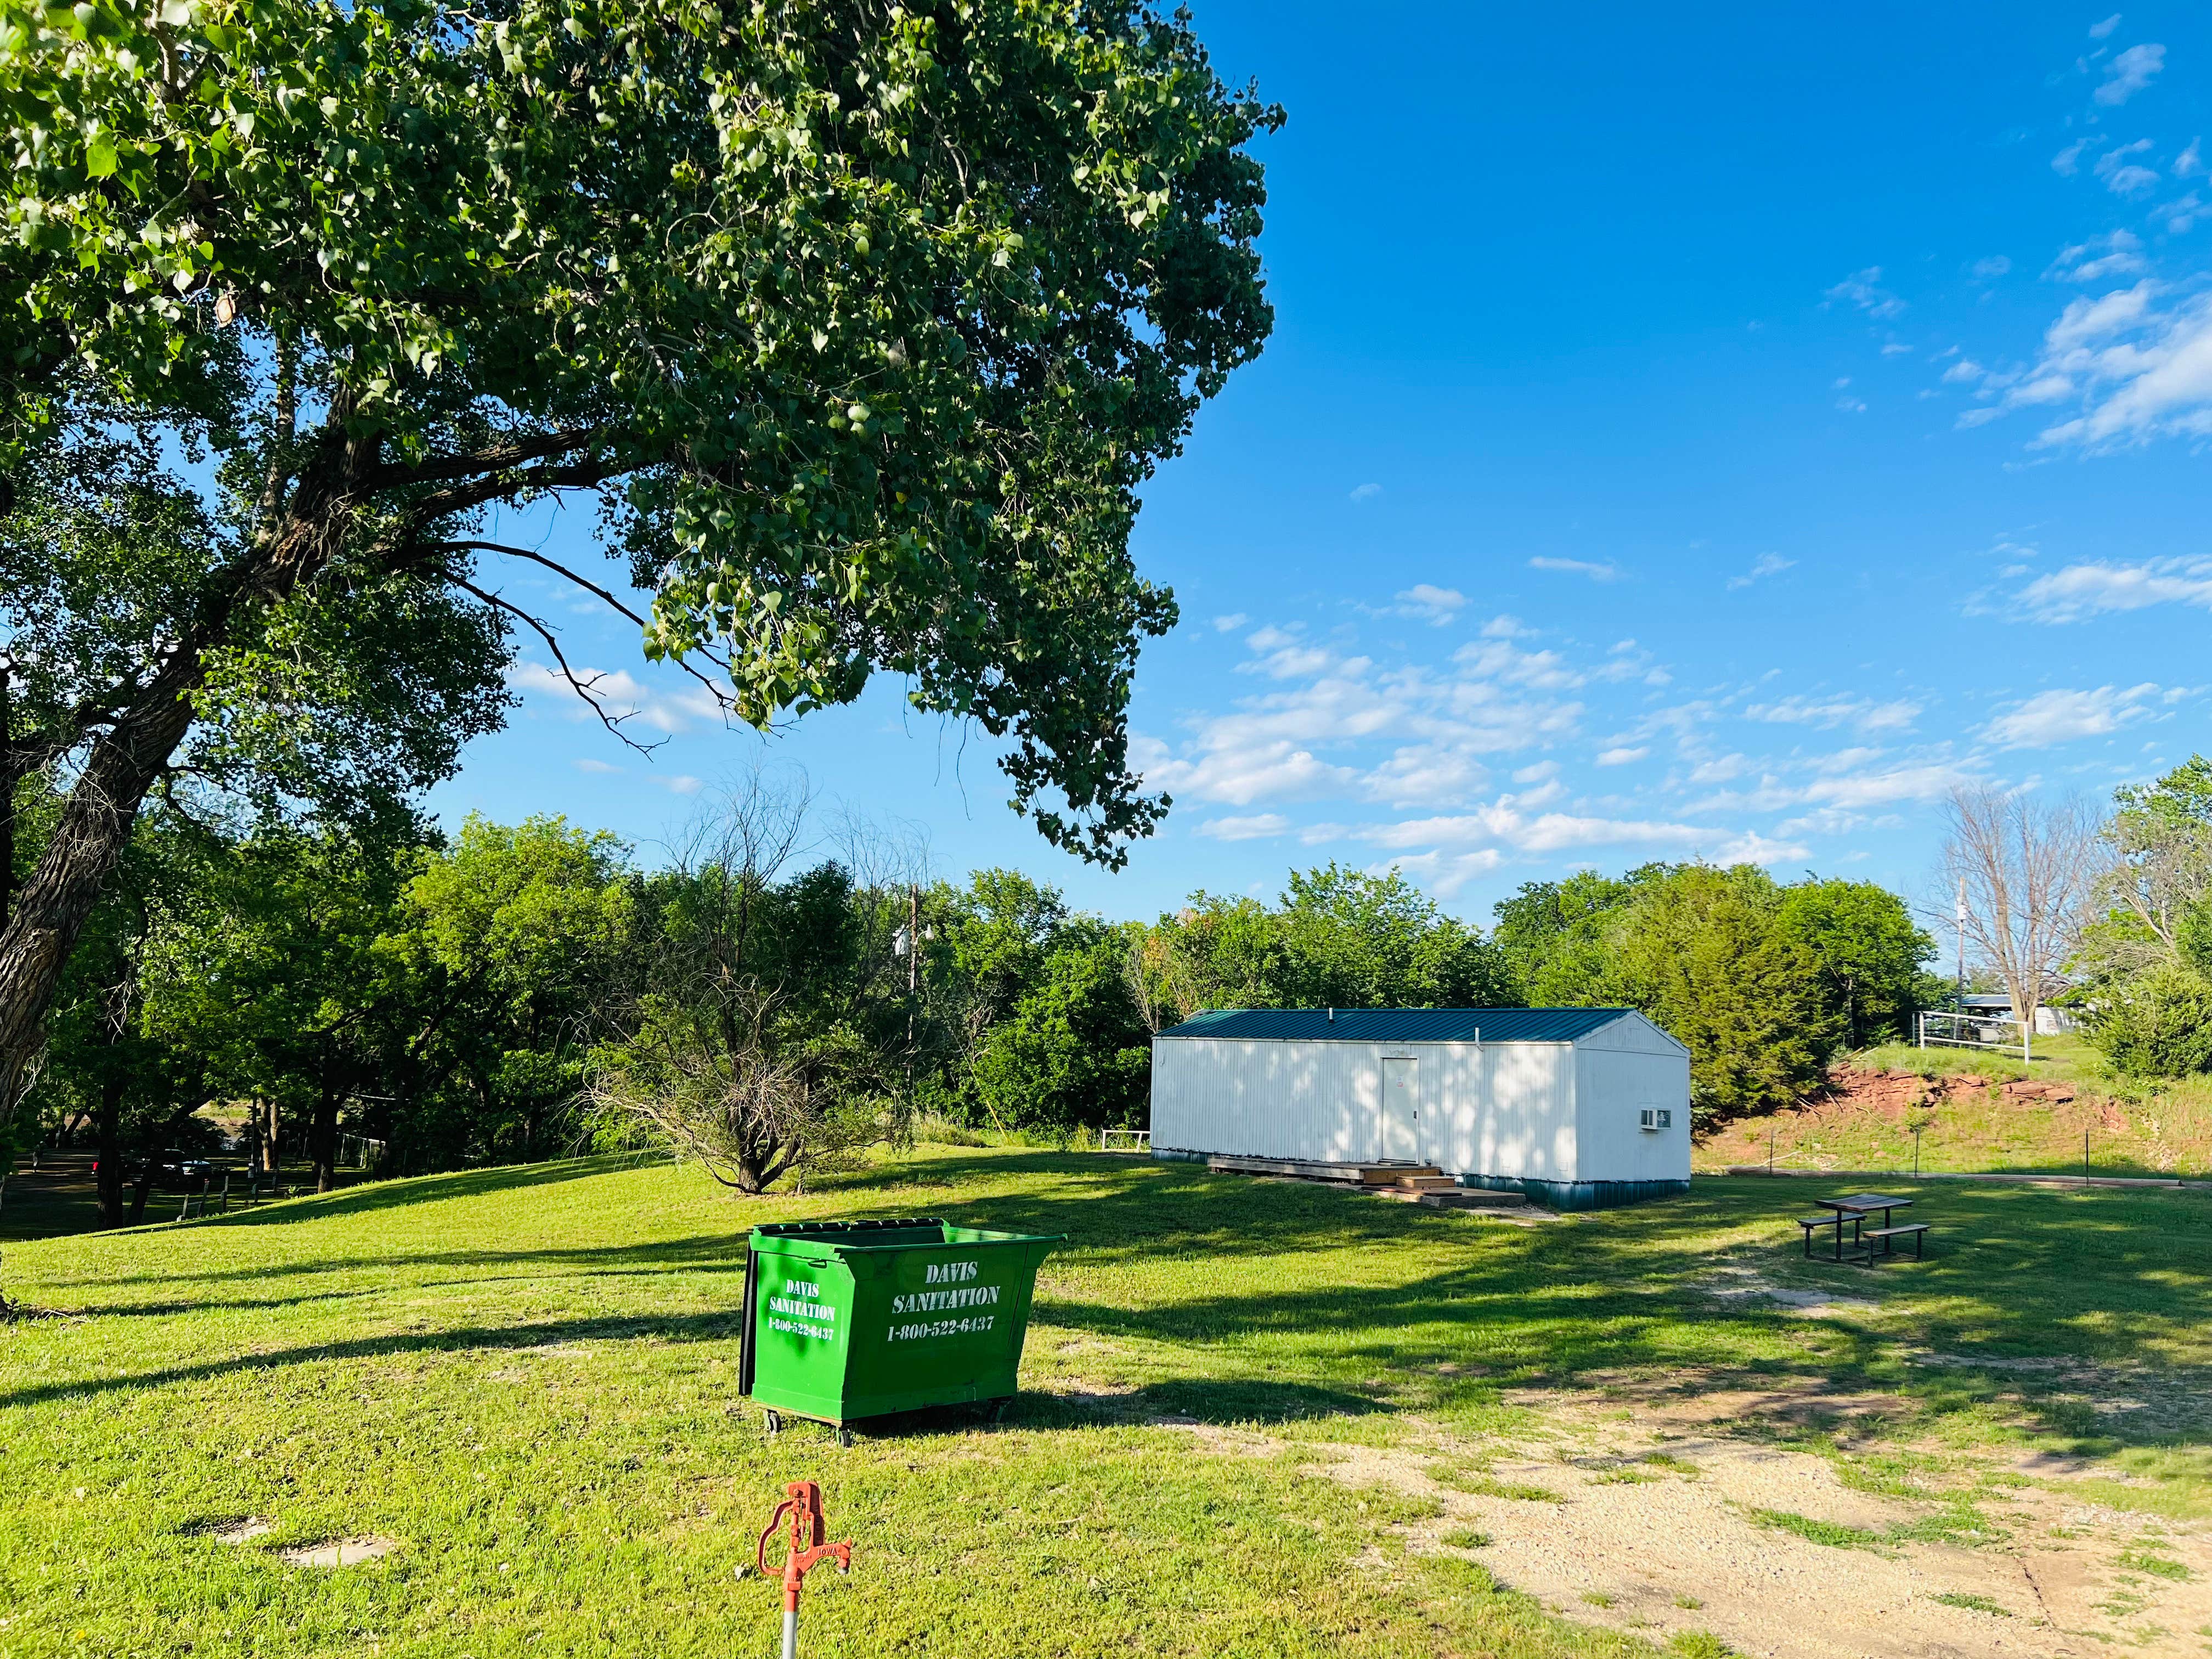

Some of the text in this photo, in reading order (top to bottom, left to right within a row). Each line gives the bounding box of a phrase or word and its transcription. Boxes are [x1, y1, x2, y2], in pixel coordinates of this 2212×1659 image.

[926, 1262, 978, 1283] DAVIS
[786, 1279, 819, 1297] DAVIS
[891, 1286, 1001, 1313] SANITATION
[770, 1296, 836, 1321] SANITATION
[769, 1317, 834, 1341] 1-800-522-6437
[887, 1316, 995, 1341] 1-800-522-6437
[819, 1547, 837, 1555] IOWA
